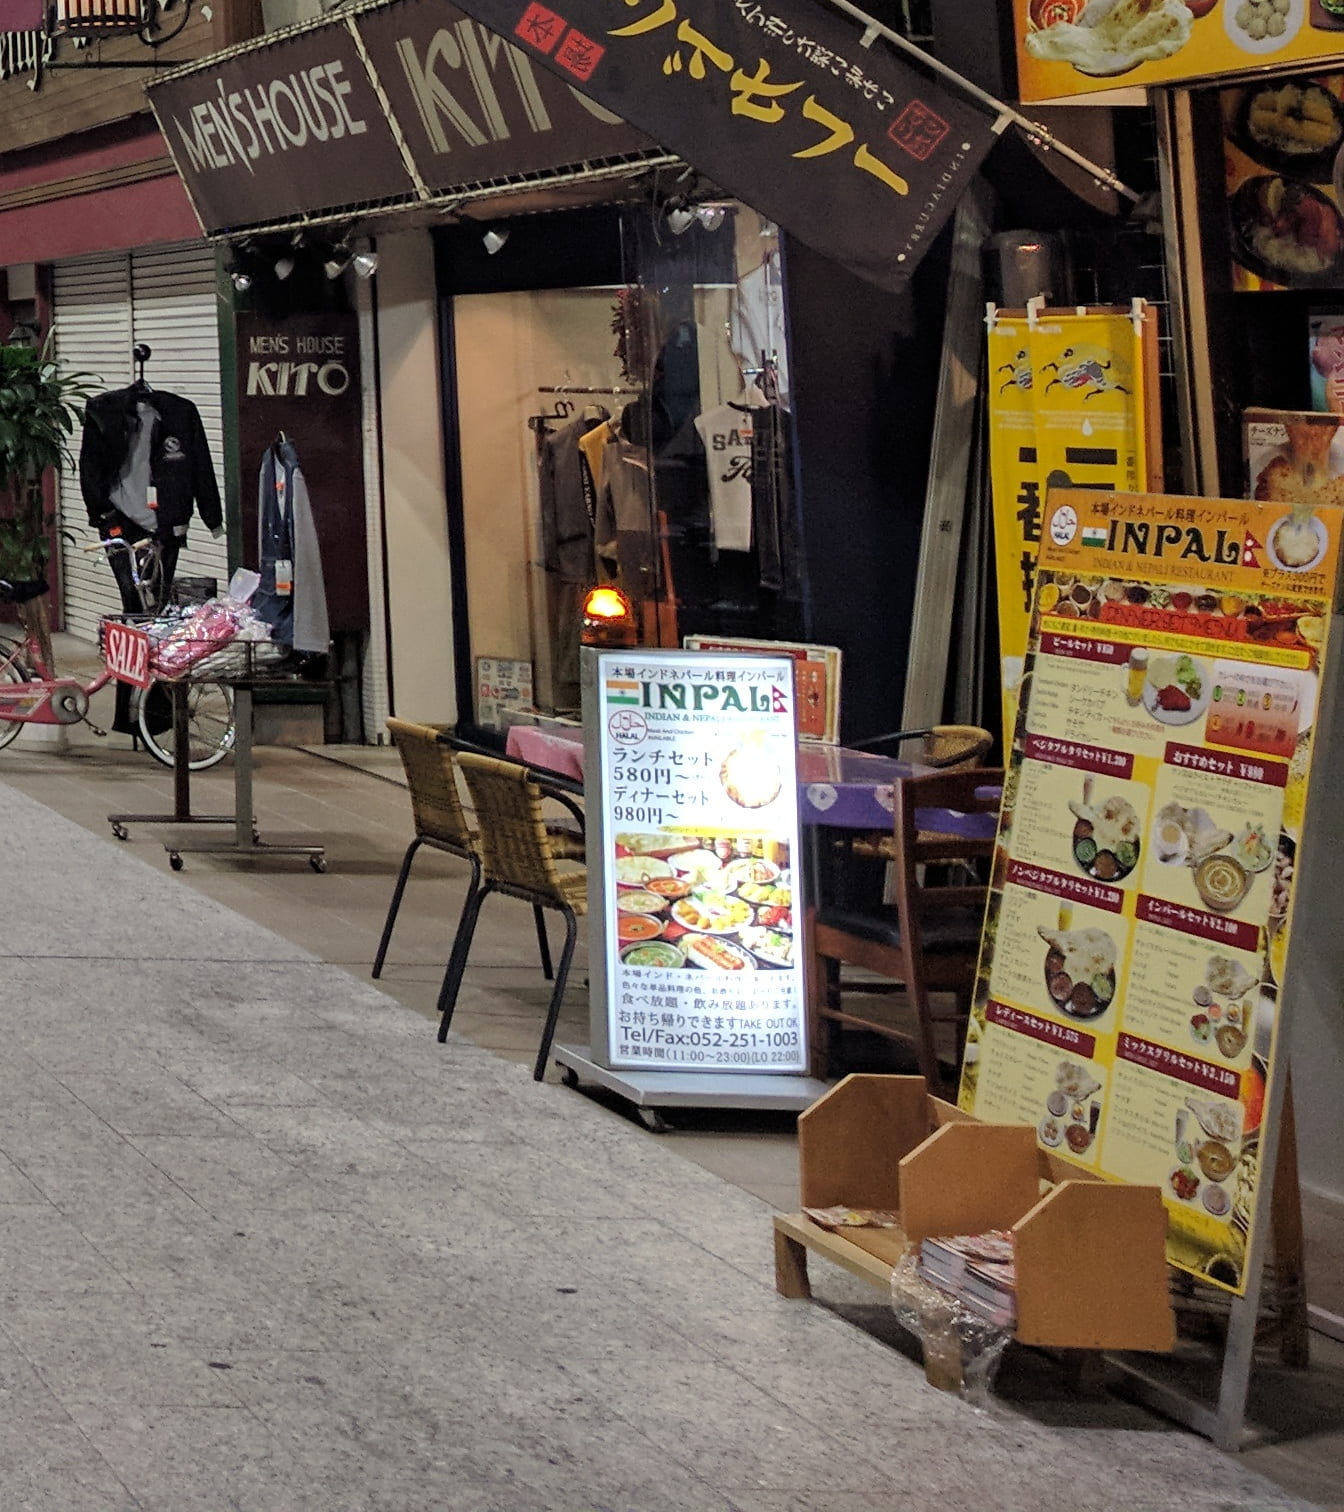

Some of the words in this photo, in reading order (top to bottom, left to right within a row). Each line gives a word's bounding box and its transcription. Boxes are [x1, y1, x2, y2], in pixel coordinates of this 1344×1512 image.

[396, 16, 626, 155] KIT
[253, 60, 367, 162] HOUSE
[250, 334, 290, 355] MEN'S
[296, 335, 345, 356] HOUSE
[1107, 519, 1241, 565] INPAL
[108, 627, 148, 684] SALE
[639, 680, 771, 713] INPAL
[644, 711, 681, 722] INDIAN
[682, 713, 691, 722] &
[615, 731, 640, 742] HALAL
[612, 746, 713, 767] ランチセット
[613, 785, 710, 807] ディナーセット
[618, 1009, 740, 1031] お持ち帰りできます
[740, 1017, 763, 1030] TAKE
[765, 1017, 786, 1030] OUT
[619, 1024, 799, 1048] Tel/Fax:052-251-1003
